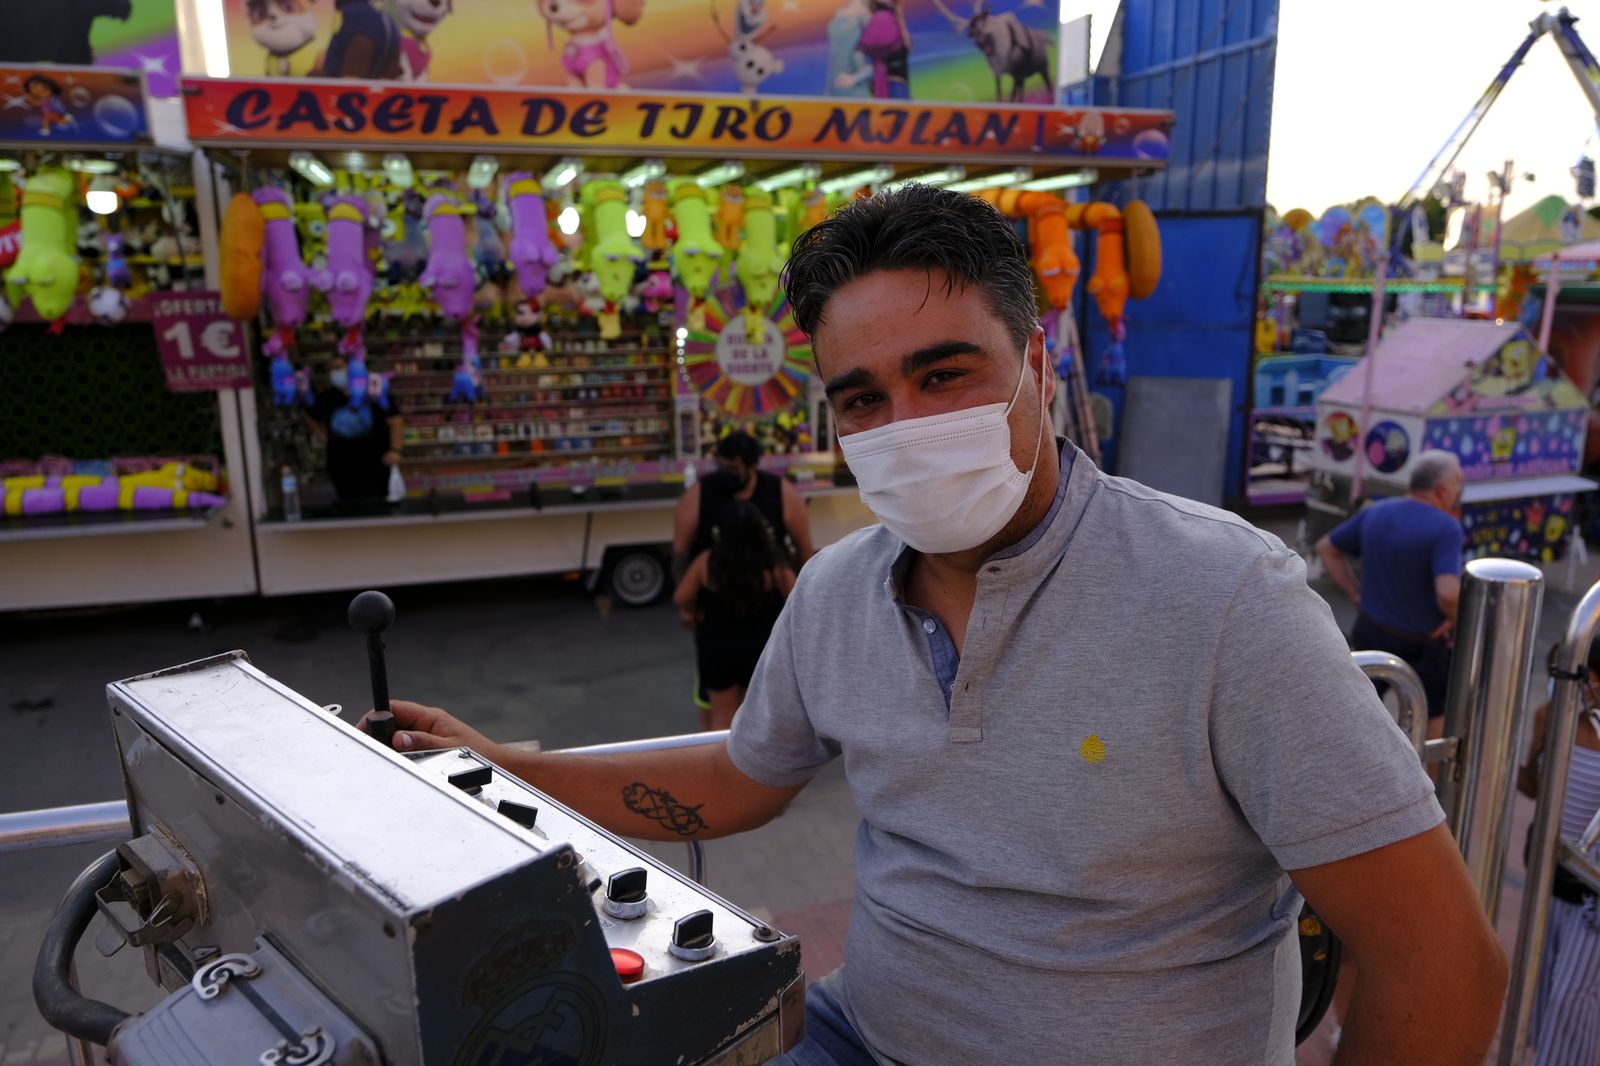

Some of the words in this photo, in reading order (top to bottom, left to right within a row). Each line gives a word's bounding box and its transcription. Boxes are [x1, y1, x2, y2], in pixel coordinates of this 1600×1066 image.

[226, 88, 499, 135] CASETA
[520, 97, 609, 138] DE
[638, 102, 792, 142] TIRO
[813, 107, 1018, 146] MILAN
